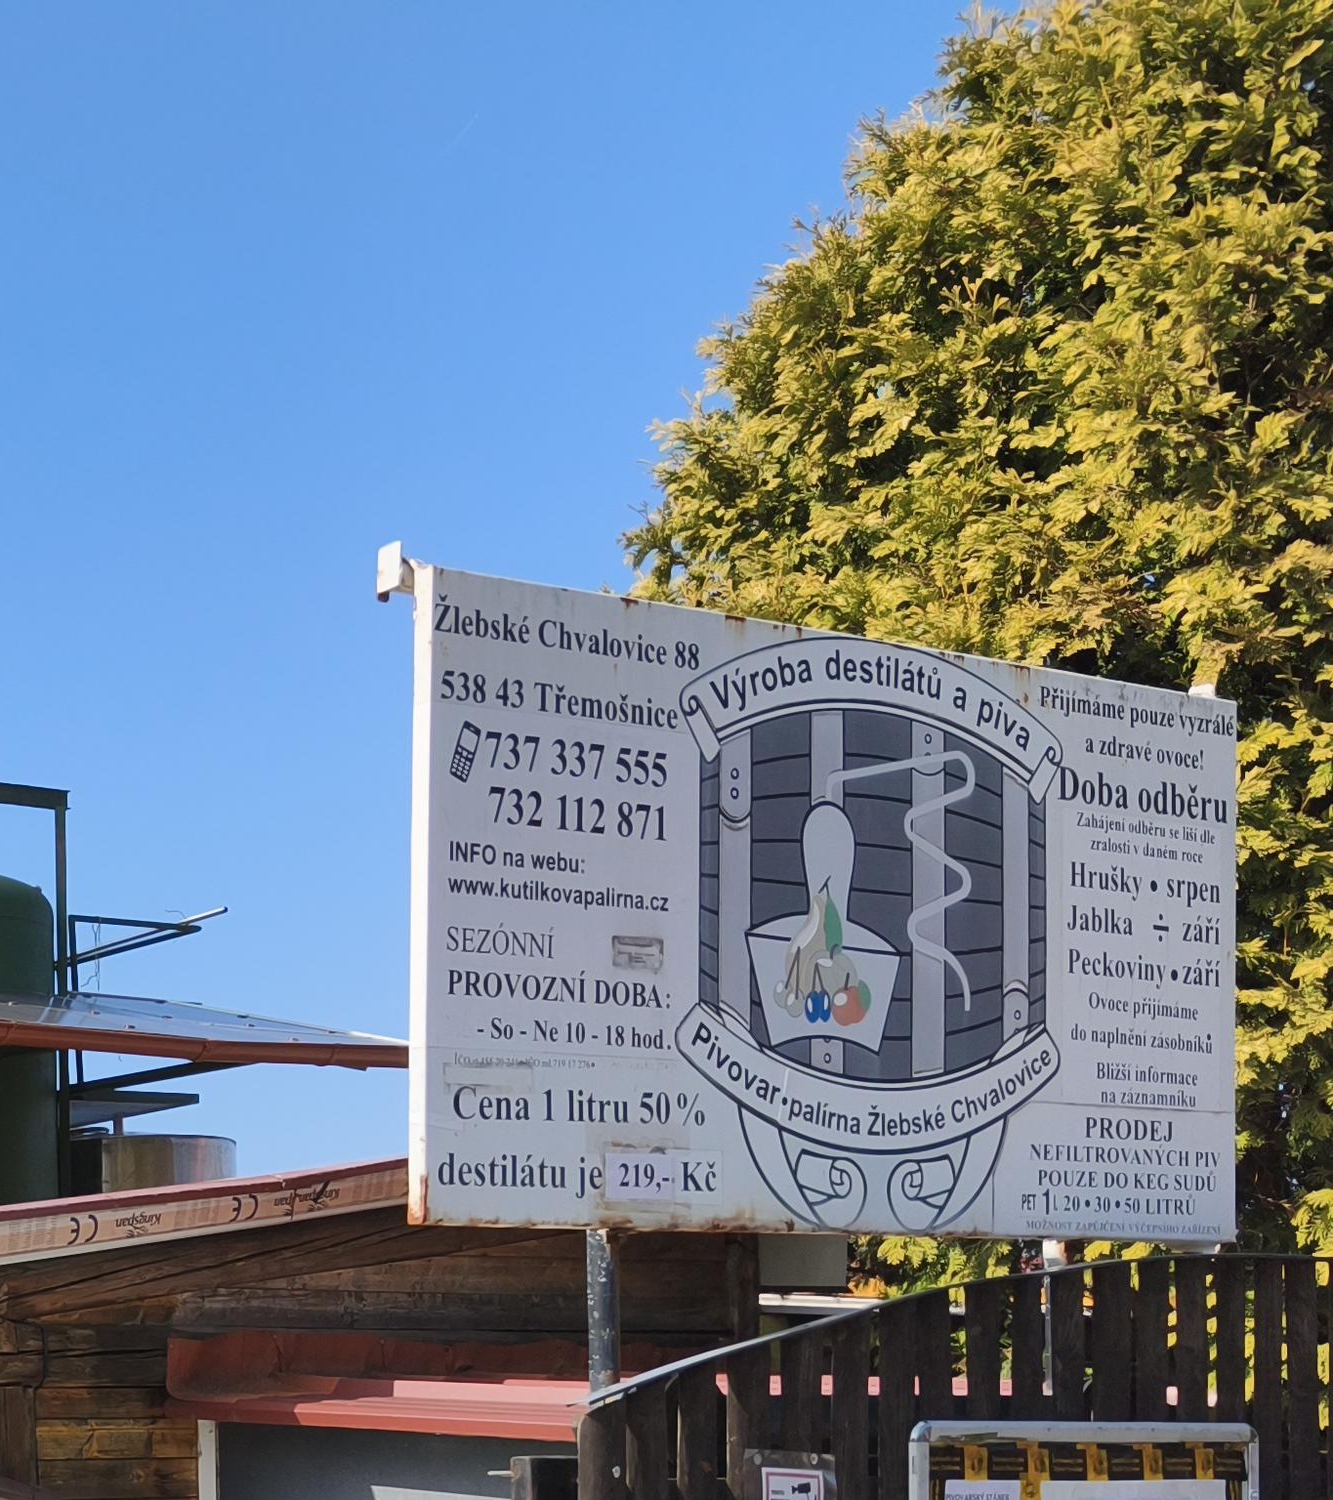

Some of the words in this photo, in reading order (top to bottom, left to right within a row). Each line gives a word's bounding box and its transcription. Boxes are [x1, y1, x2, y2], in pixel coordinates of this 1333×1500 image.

[434, 594, 530, 644] Žlebské
[538, 619, 667, 665] Chvalovice
[675, 641, 700, 670] 88
[440, 670, 486, 703] 538
[495, 678, 524, 708] 43
[534, 682, 678, 729] Třemošnice
[710, 656, 812, 712] Výroba
[825, 649, 941, 700] destilátů
[952, 686, 967, 712] a
[976, 698, 1031, 751] piva
[1039, 686, 1125, 720] Přijímáme
[1130, 705, 1175, 728] pouze
[1179, 714, 1234, 737] vyzrálé
[485, 731, 540, 772] 737
[551, 739, 605, 779] 337
[615, 748, 667, 788] 555
[1085, 737, 1094, 753] a
[1099, 736, 1152, 762] zdravé
[1157, 749, 1204, 770] ovoce!
[1057, 766, 1128, 810] Doba
[1138, 781, 1228, 824] odběru
[488, 786, 543, 827] 732
[557, 794, 605, 834] 112
[617, 801, 667, 841] 871
[1077, 812, 1125, 834] Zahájení
[1128, 820, 1166, 838] odběru
[1169, 828, 1179, 840] se
[1200, 830, 1216, 845] dle
[449, 840, 496, 865] INFO
[503, 850, 524, 868] na
[531, 852, 585, 874] webu:
[1090, 838, 1131, 855] zralosti
[1133, 846, 1140, 855] v
[1143, 844, 1178, 860] daném
[1182, 852, 1203, 864] roce
[448, 877, 669, 911] www.kutilkovapalirna.cz
[1070, 861, 1142, 901] Hrušky
[1167, 877, 1220, 908] srpen
[446, 923, 554, 959] SEZÓNNÍ
[1067, 905, 1133, 936] Jablka
[1182, 915, 1220, 945] září
[1069, 949, 1166, 990] Peckoviny
[1182, 958, 1220, 987] září
[448, 970, 585, 1003] PROVOZNÍ
[595, 980, 671, 1009] DOBA:
[1089, 992, 1129, 1013] Ovoce
[1133, 998, 1198, 1021] přijímáme
[490, 1017, 513, 1040] So
[533, 1019, 558, 1042] Ne
[566, 1022, 585, 1044] 10
[605, 1025, 624, 1047] 18
[631, 1027, 671, 1050] hod.
[1071, 1023, 1087, 1041] do
[1091, 1027, 1146, 1048] naplnění
[787, 1095, 861, 1135] palírna
[867, 1104, 945, 1137] Žlebské
[950, 1048, 1052, 1124] Chvalovice
[1135, 1065, 1198, 1086] informace
[453, 1085, 530, 1121] Cena
[543, 1089, 555, 1122] 1
[567, 1089, 629, 1124] litru
[1101, 1090, 1116, 1104] na
[1120, 1087, 1197, 1107] záznamníku
[1085, 1117, 1173, 1143] PRODEJ
[1030, 1143, 1189, 1167] NEFILTROVANÝCH
[1195, 1151, 1221, 1168] PIV
[438, 1153, 566, 1188] destilátu
[576, 1156, 603, 1199] je
[681, 1160, 717, 1193] Kč
[1038, 1169, 1098, 1188] POUZE
[1104, 1172, 1128, 1189] DO
[1134, 1174, 1169, 1191] KEG
[1174, 1170, 1217, 1192] SUDŮ
[116, 1211, 162, 1227] Kingspan
[1021, 1194, 1036, 1211] PET
[1063, 1195, 1080, 1212] 20
[1094, 1196, 1110, 1213] 30
[1124, 1197, 1140, 1214] 50
[1146, 1194, 1196, 1216] LITRŮ
